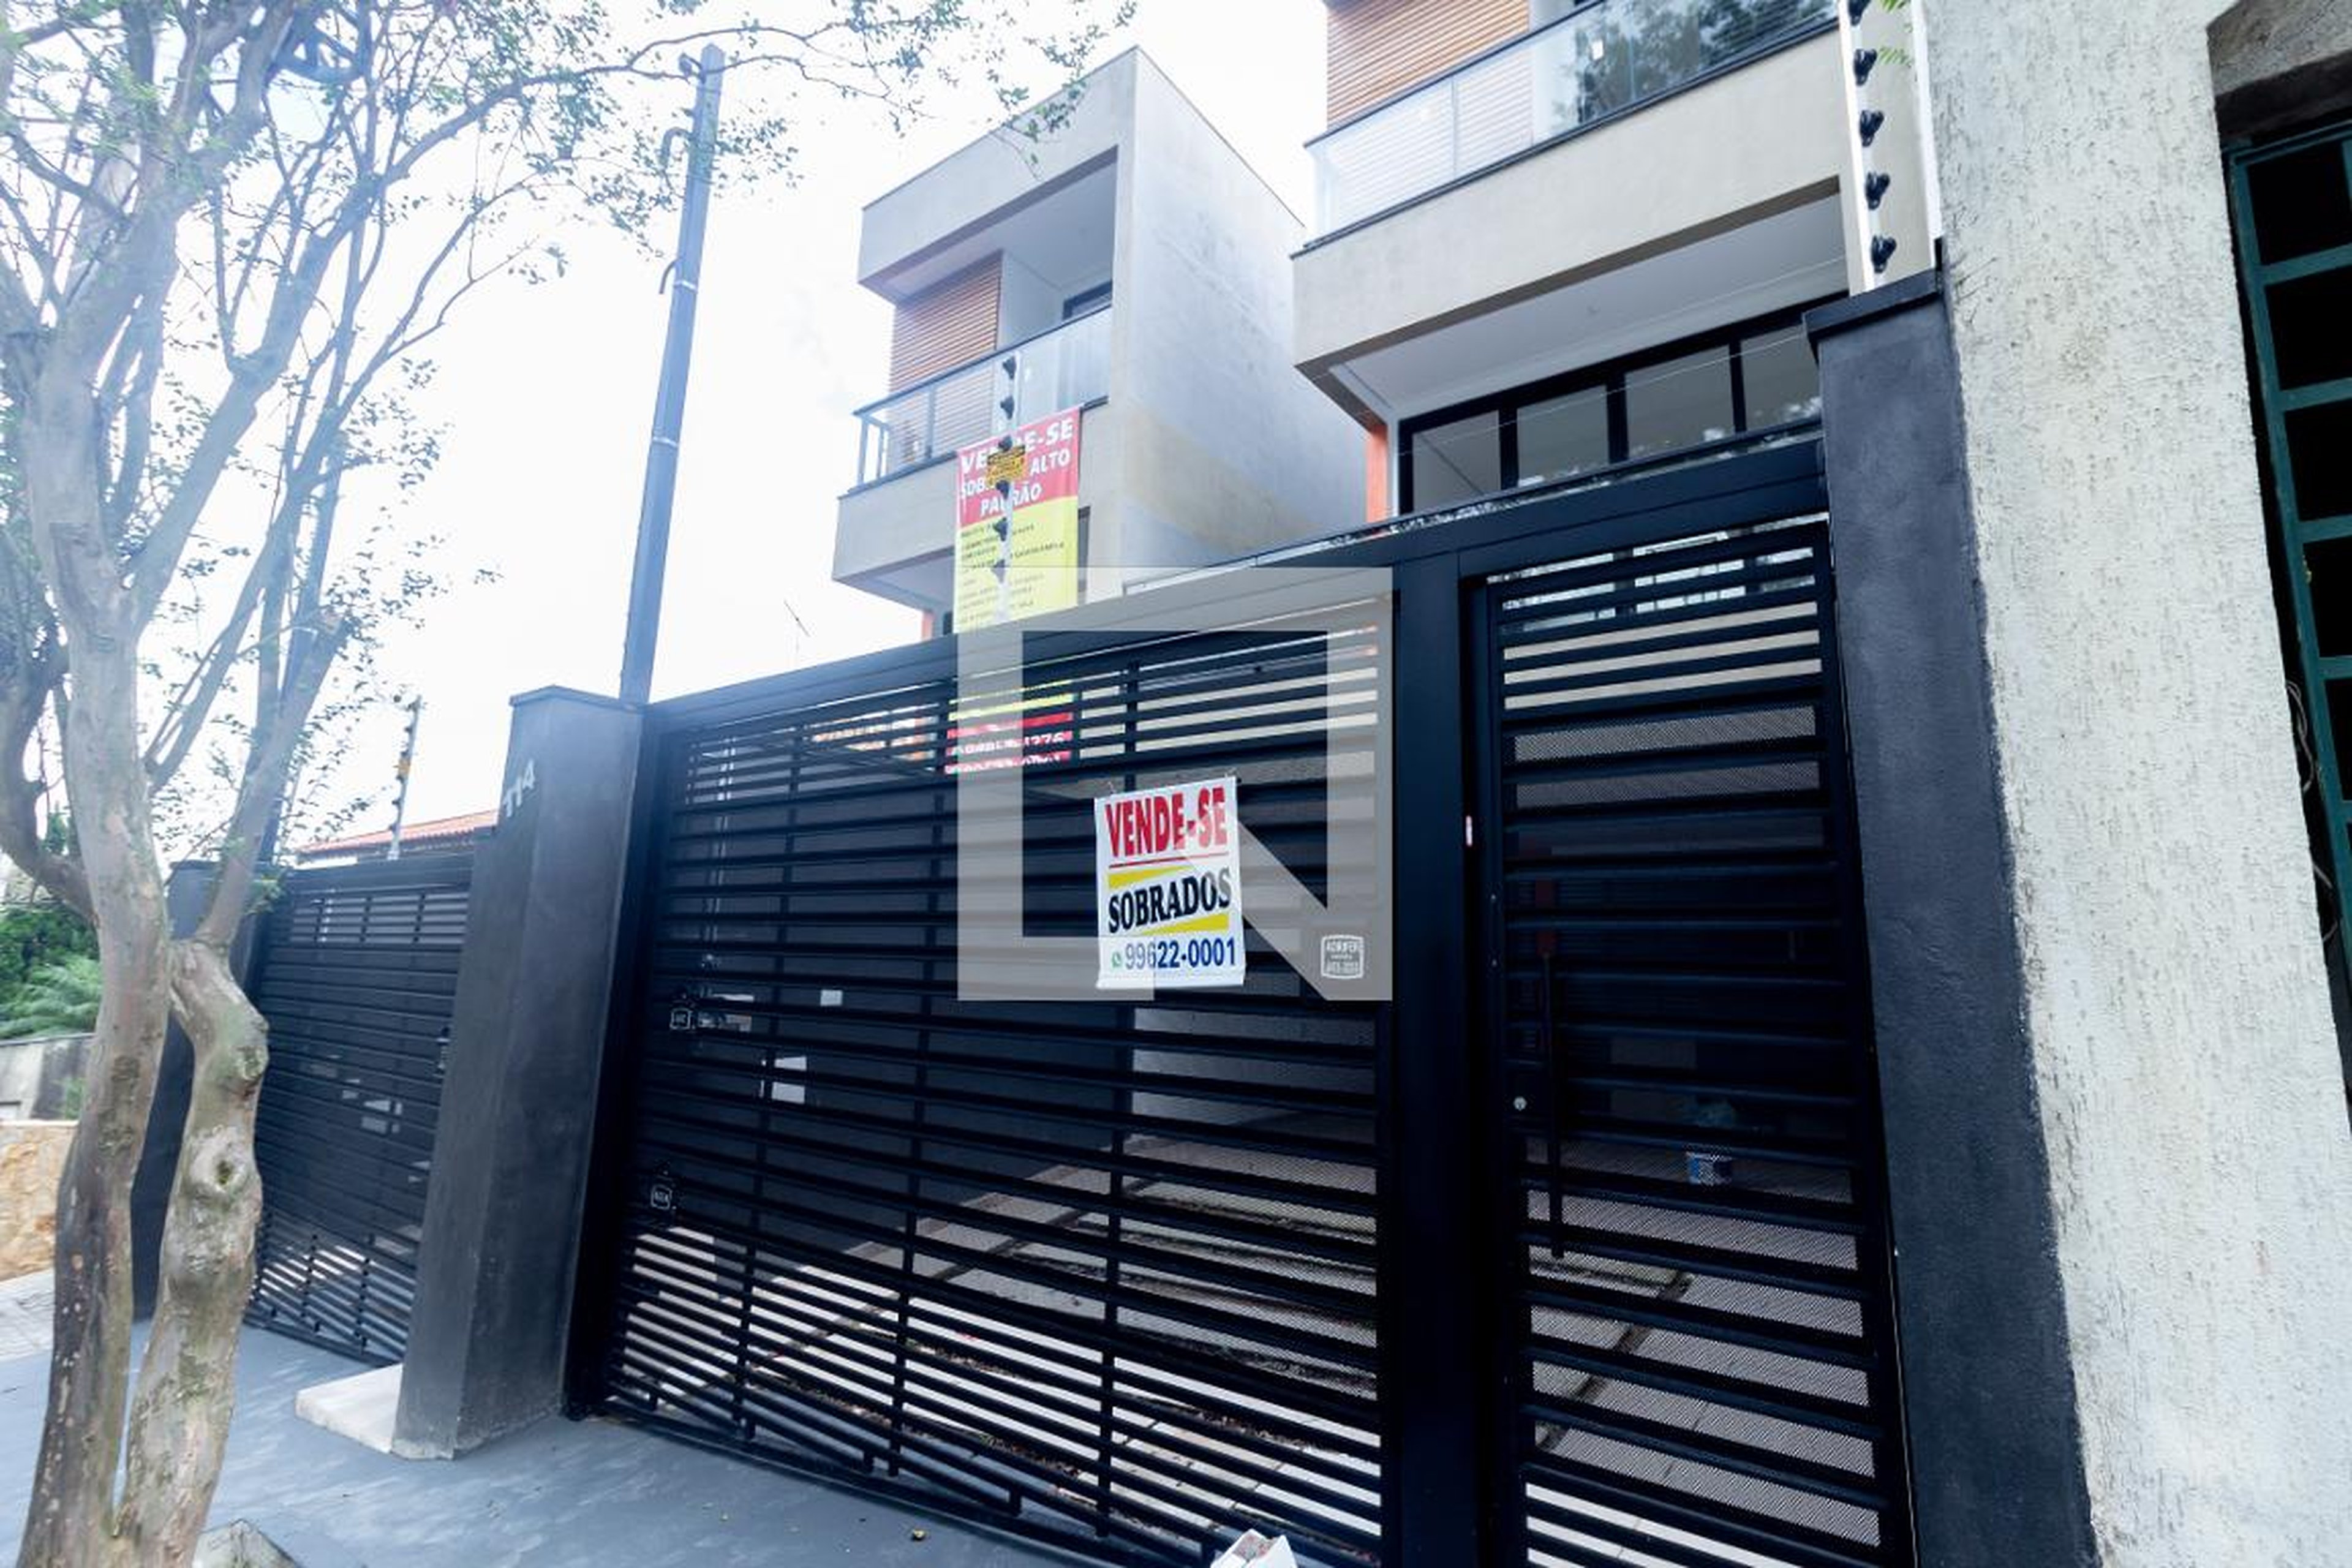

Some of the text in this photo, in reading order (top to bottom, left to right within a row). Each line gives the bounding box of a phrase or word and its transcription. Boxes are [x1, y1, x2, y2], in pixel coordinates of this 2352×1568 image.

[1030, 448, 1071, 477] ALTO
[1105, 786, 1227, 858] VENDE-SE
[1108, 866, 1232, 933] SOBRADOS
[1125, 937, 1235, 970] 99622-0001
